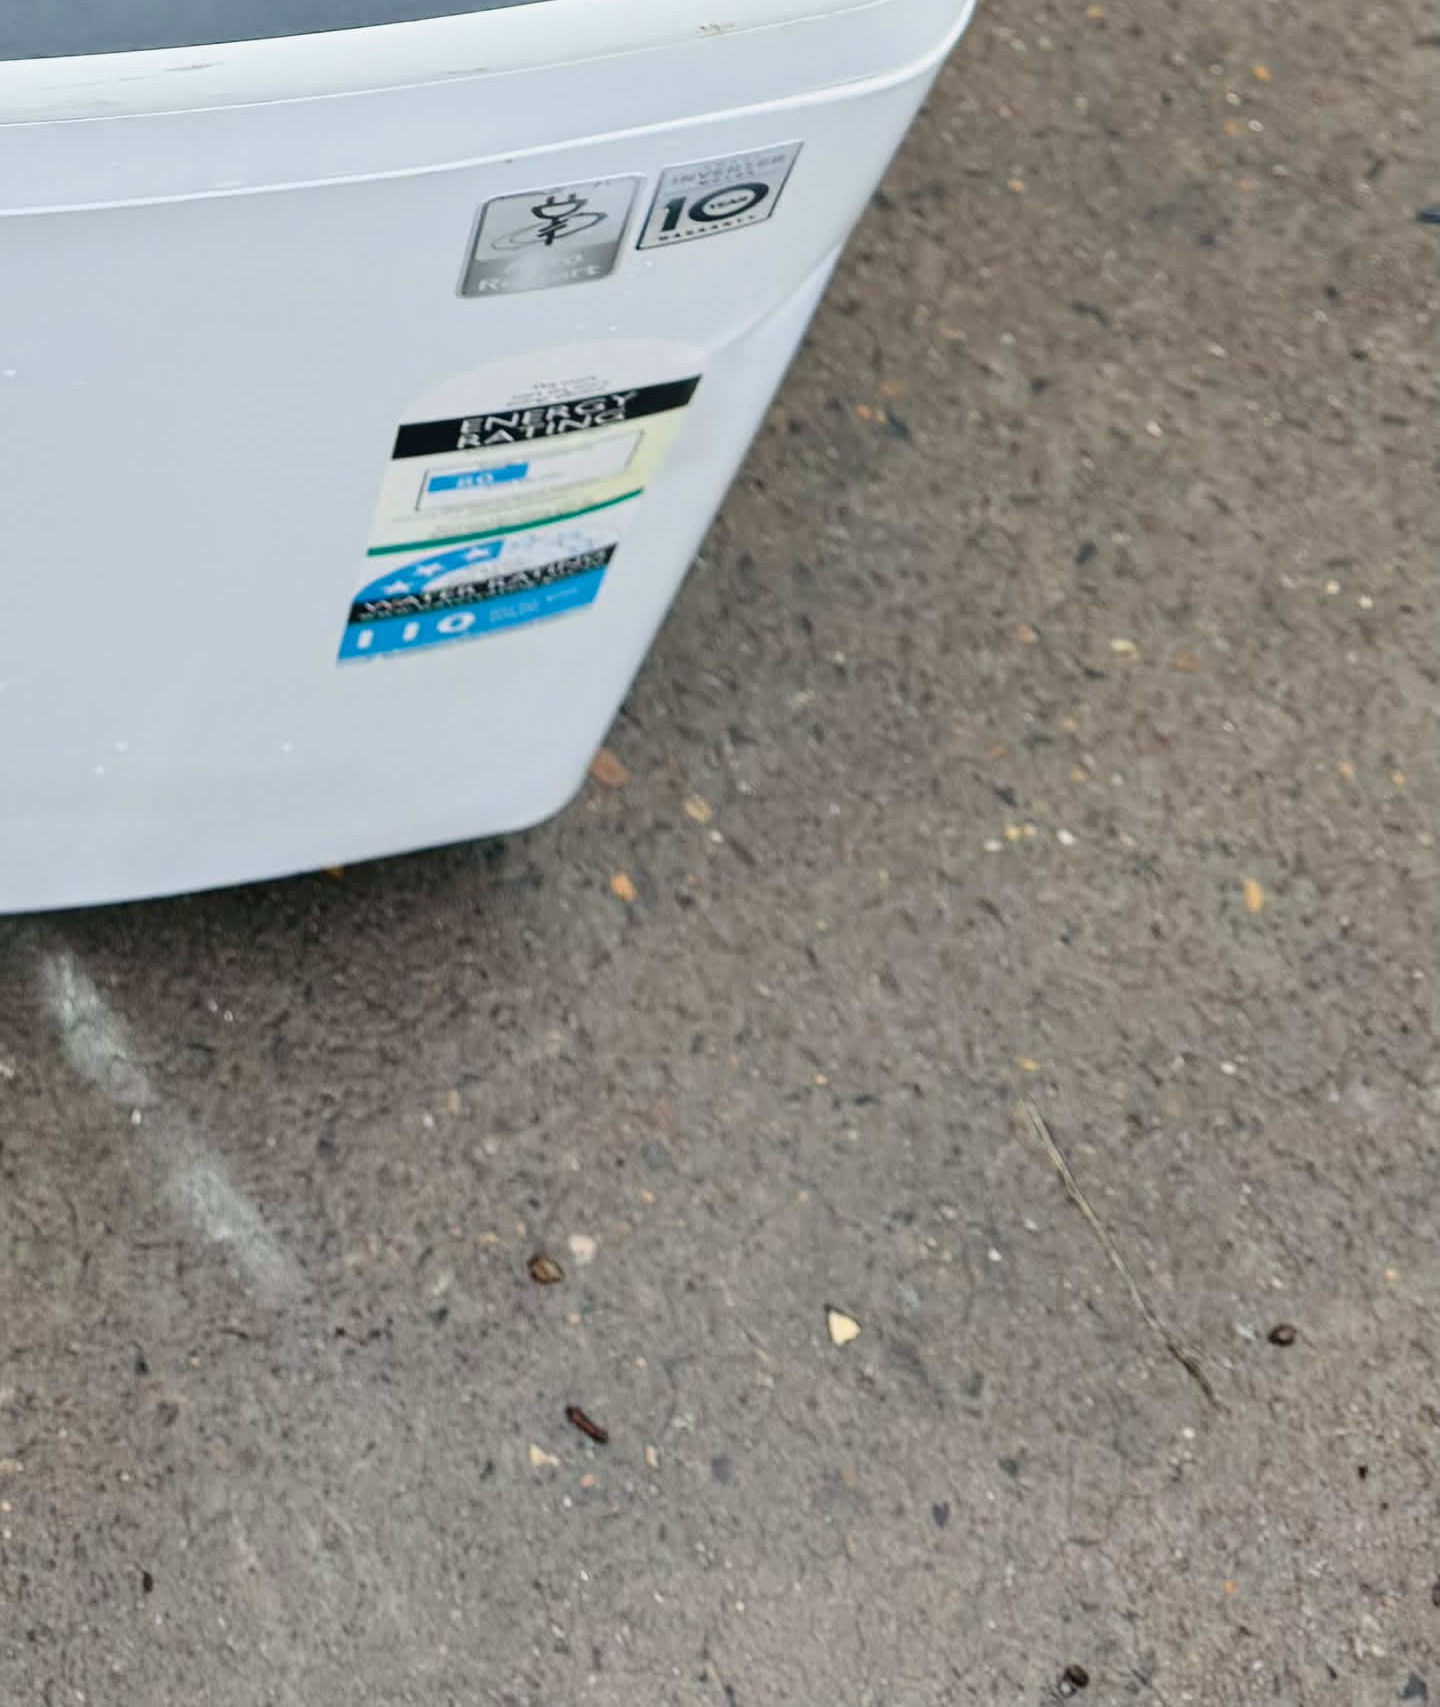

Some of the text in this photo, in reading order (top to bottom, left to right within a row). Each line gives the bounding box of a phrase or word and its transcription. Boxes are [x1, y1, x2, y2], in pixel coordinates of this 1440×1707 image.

[661, 182, 769, 232] 10
[456, 408, 627, 449] RATING
[460, 390, 638, 434] ENERGY
